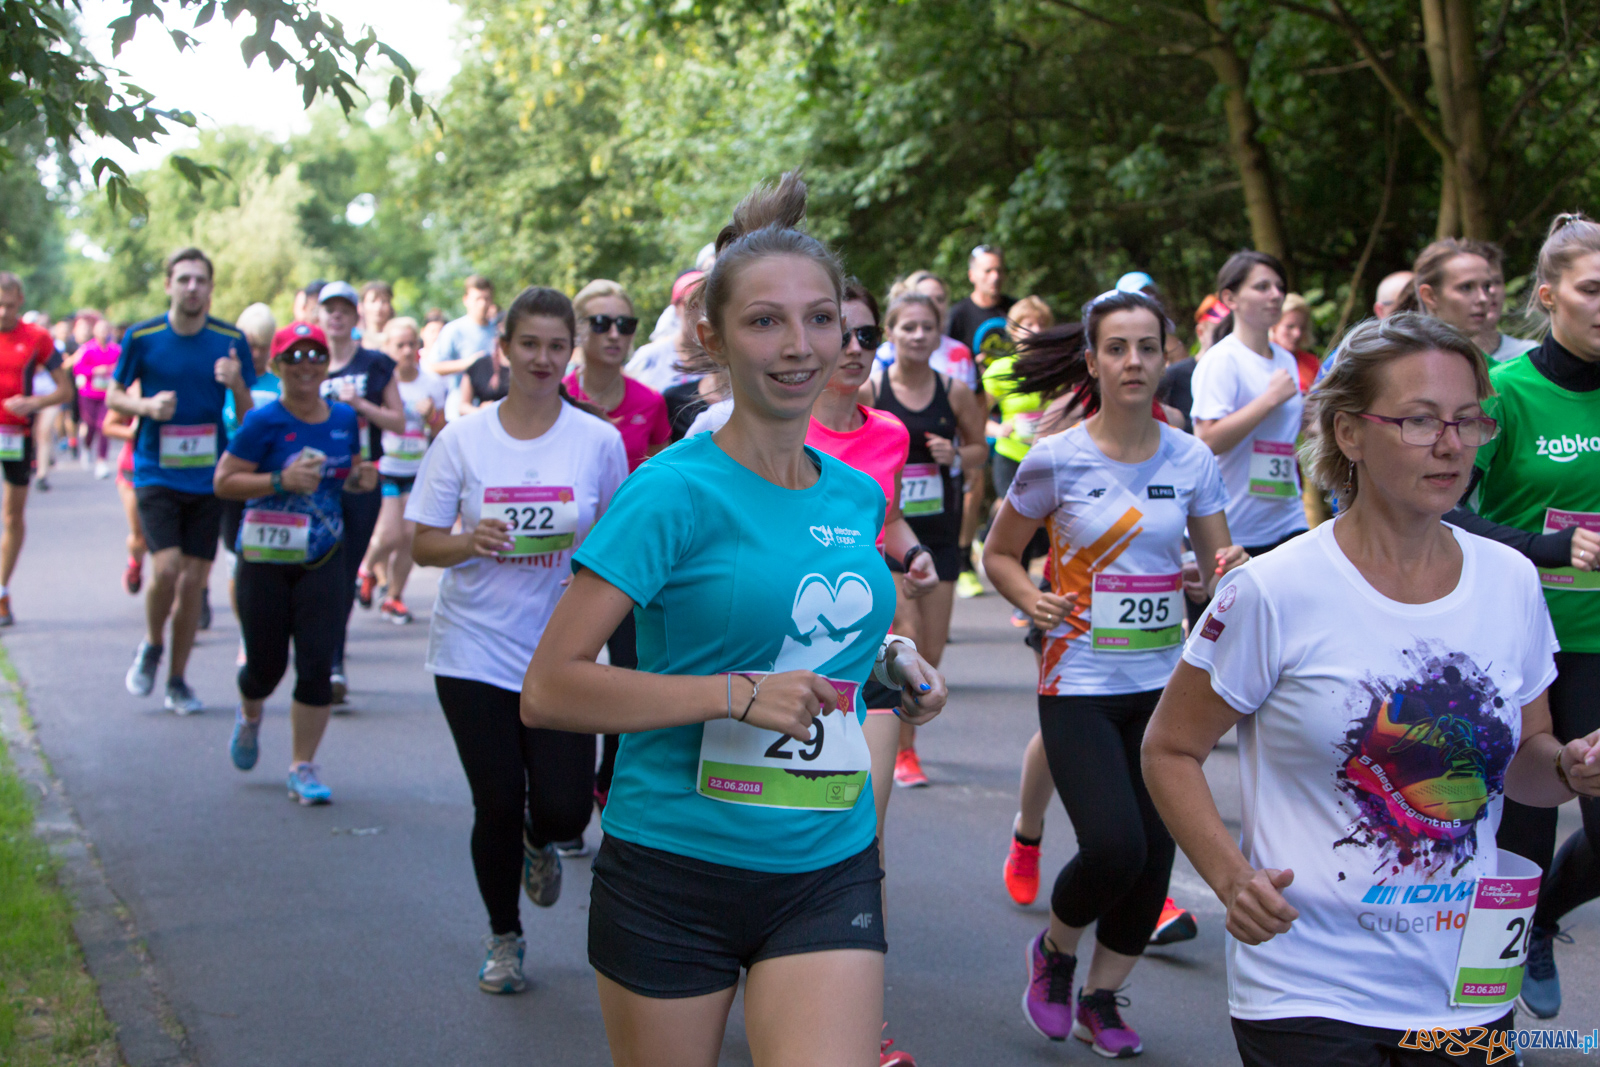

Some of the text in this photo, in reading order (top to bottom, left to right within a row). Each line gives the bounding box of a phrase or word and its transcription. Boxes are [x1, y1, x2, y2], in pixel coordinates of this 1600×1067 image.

[179, 438, 200, 452] 47
[901, 480, 927, 497] 77
[504, 506, 554, 531] 322
[256, 526, 291, 545] 179
[1119, 597, 1169, 624] 295
[764, 717, 824, 761] 29
[1358, 754, 1373, 766] 5
[1370, 763, 1394, 792] Bieg
[710, 778, 760, 793] 22.06.2018
[851, 912, 873, 928] 4F
[1357, 910, 1467, 933] GuberHo
[1464, 985, 1505, 994] 22.06.2018
